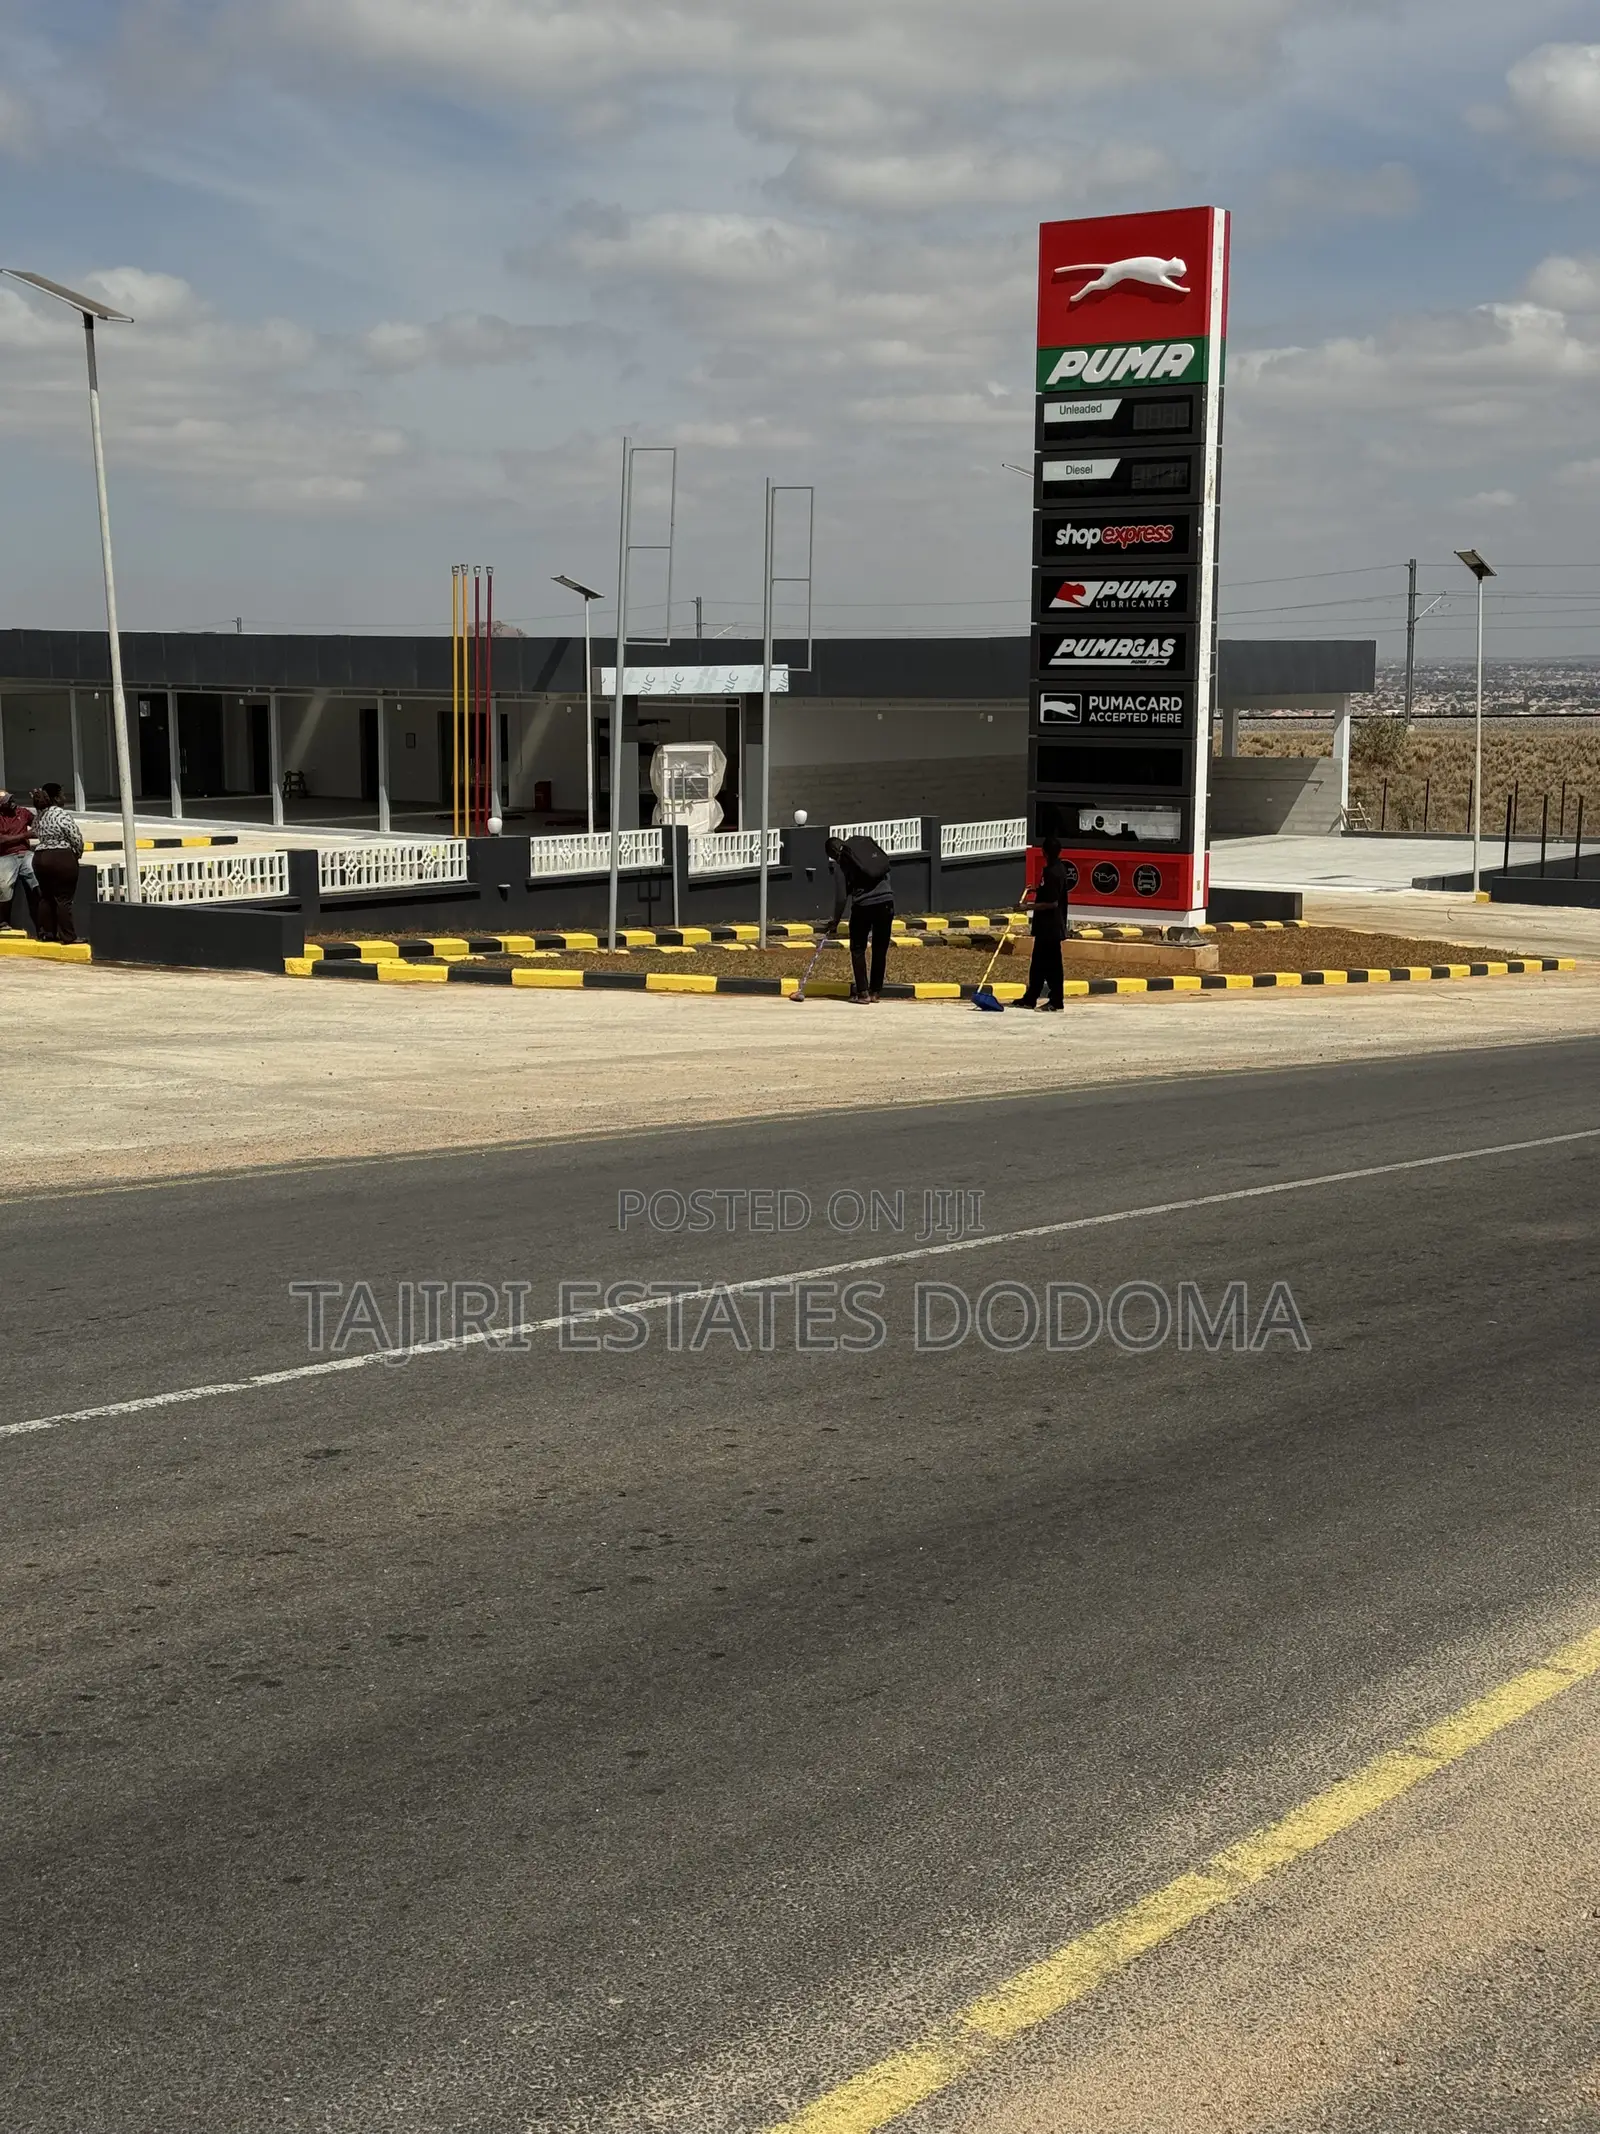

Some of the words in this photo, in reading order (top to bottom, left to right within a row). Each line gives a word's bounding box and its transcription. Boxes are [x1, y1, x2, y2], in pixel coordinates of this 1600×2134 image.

[1045, 343, 1195, 385] PUMA
[1059, 403, 1102, 415] Unleaded
[1065, 464, 1093, 476] Diesel
[1096, 580, 1177, 599] PUMA
[1095, 600, 1169, 608] LUBRICANTS
[1054, 638, 1176, 657] PUMAGAS
[1089, 696, 1183, 712] PUMACARD
[1089, 712, 1148, 723] ACCEPTED
[1151, 713, 1182, 723] HERE
